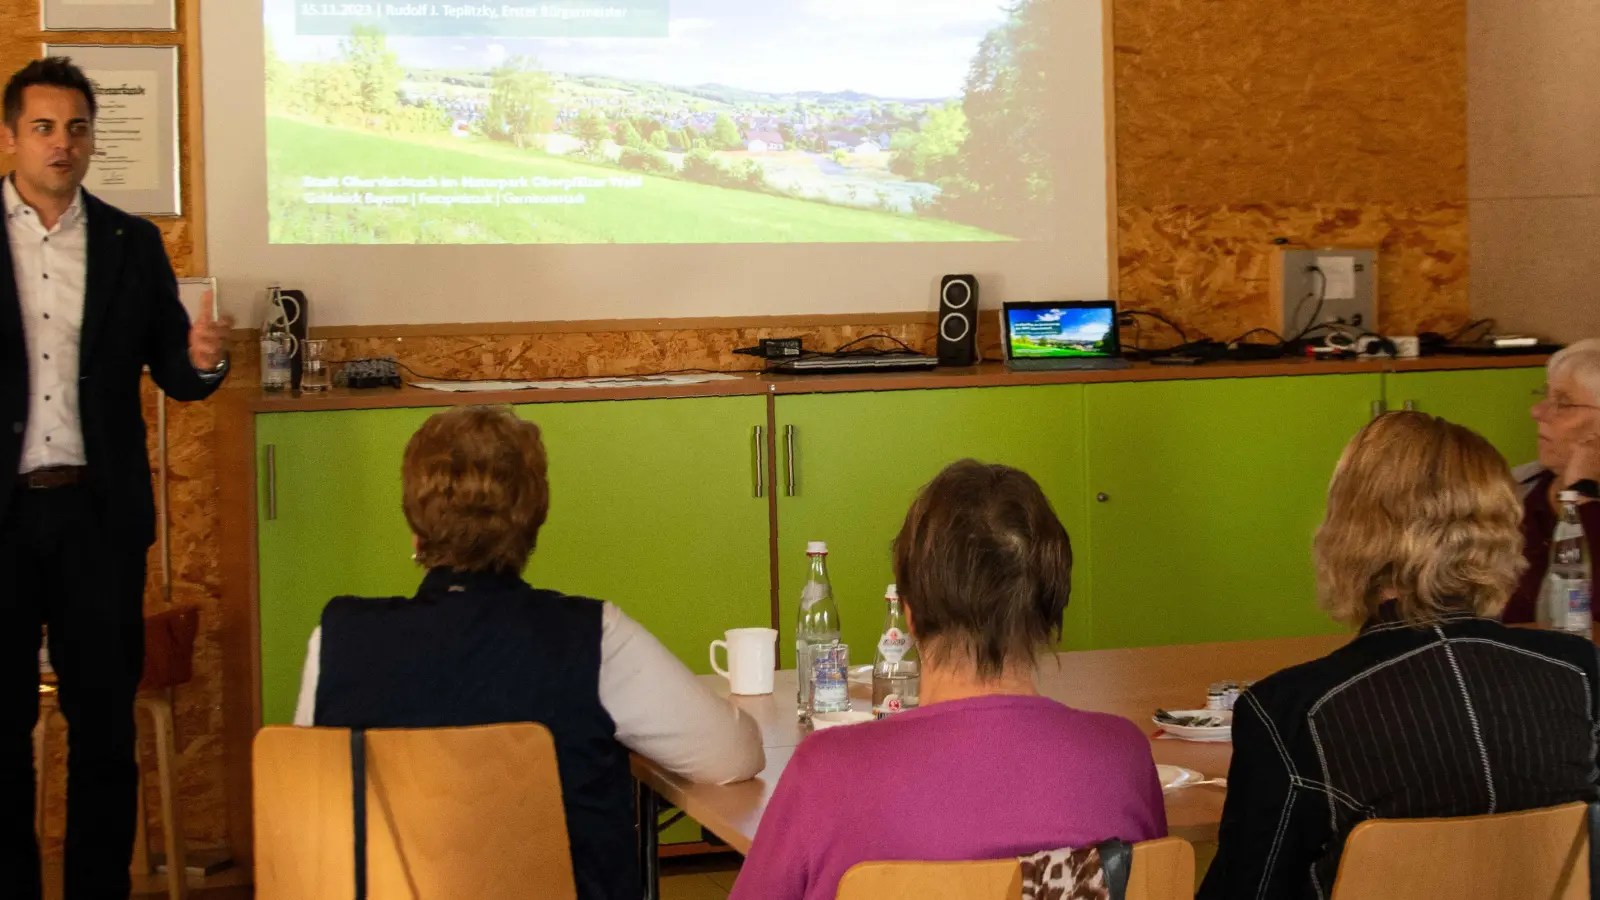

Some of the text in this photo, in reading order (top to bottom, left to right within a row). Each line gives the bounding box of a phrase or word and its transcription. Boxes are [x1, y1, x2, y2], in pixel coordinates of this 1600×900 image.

[301, 3, 373, 16] 15.11.2023
[385, 3, 428, 16] Rudolf
[430, 4, 439, 16] J.
[501, 5, 538, 17] Erster
[540, 5, 628, 20] Bürgermeister
